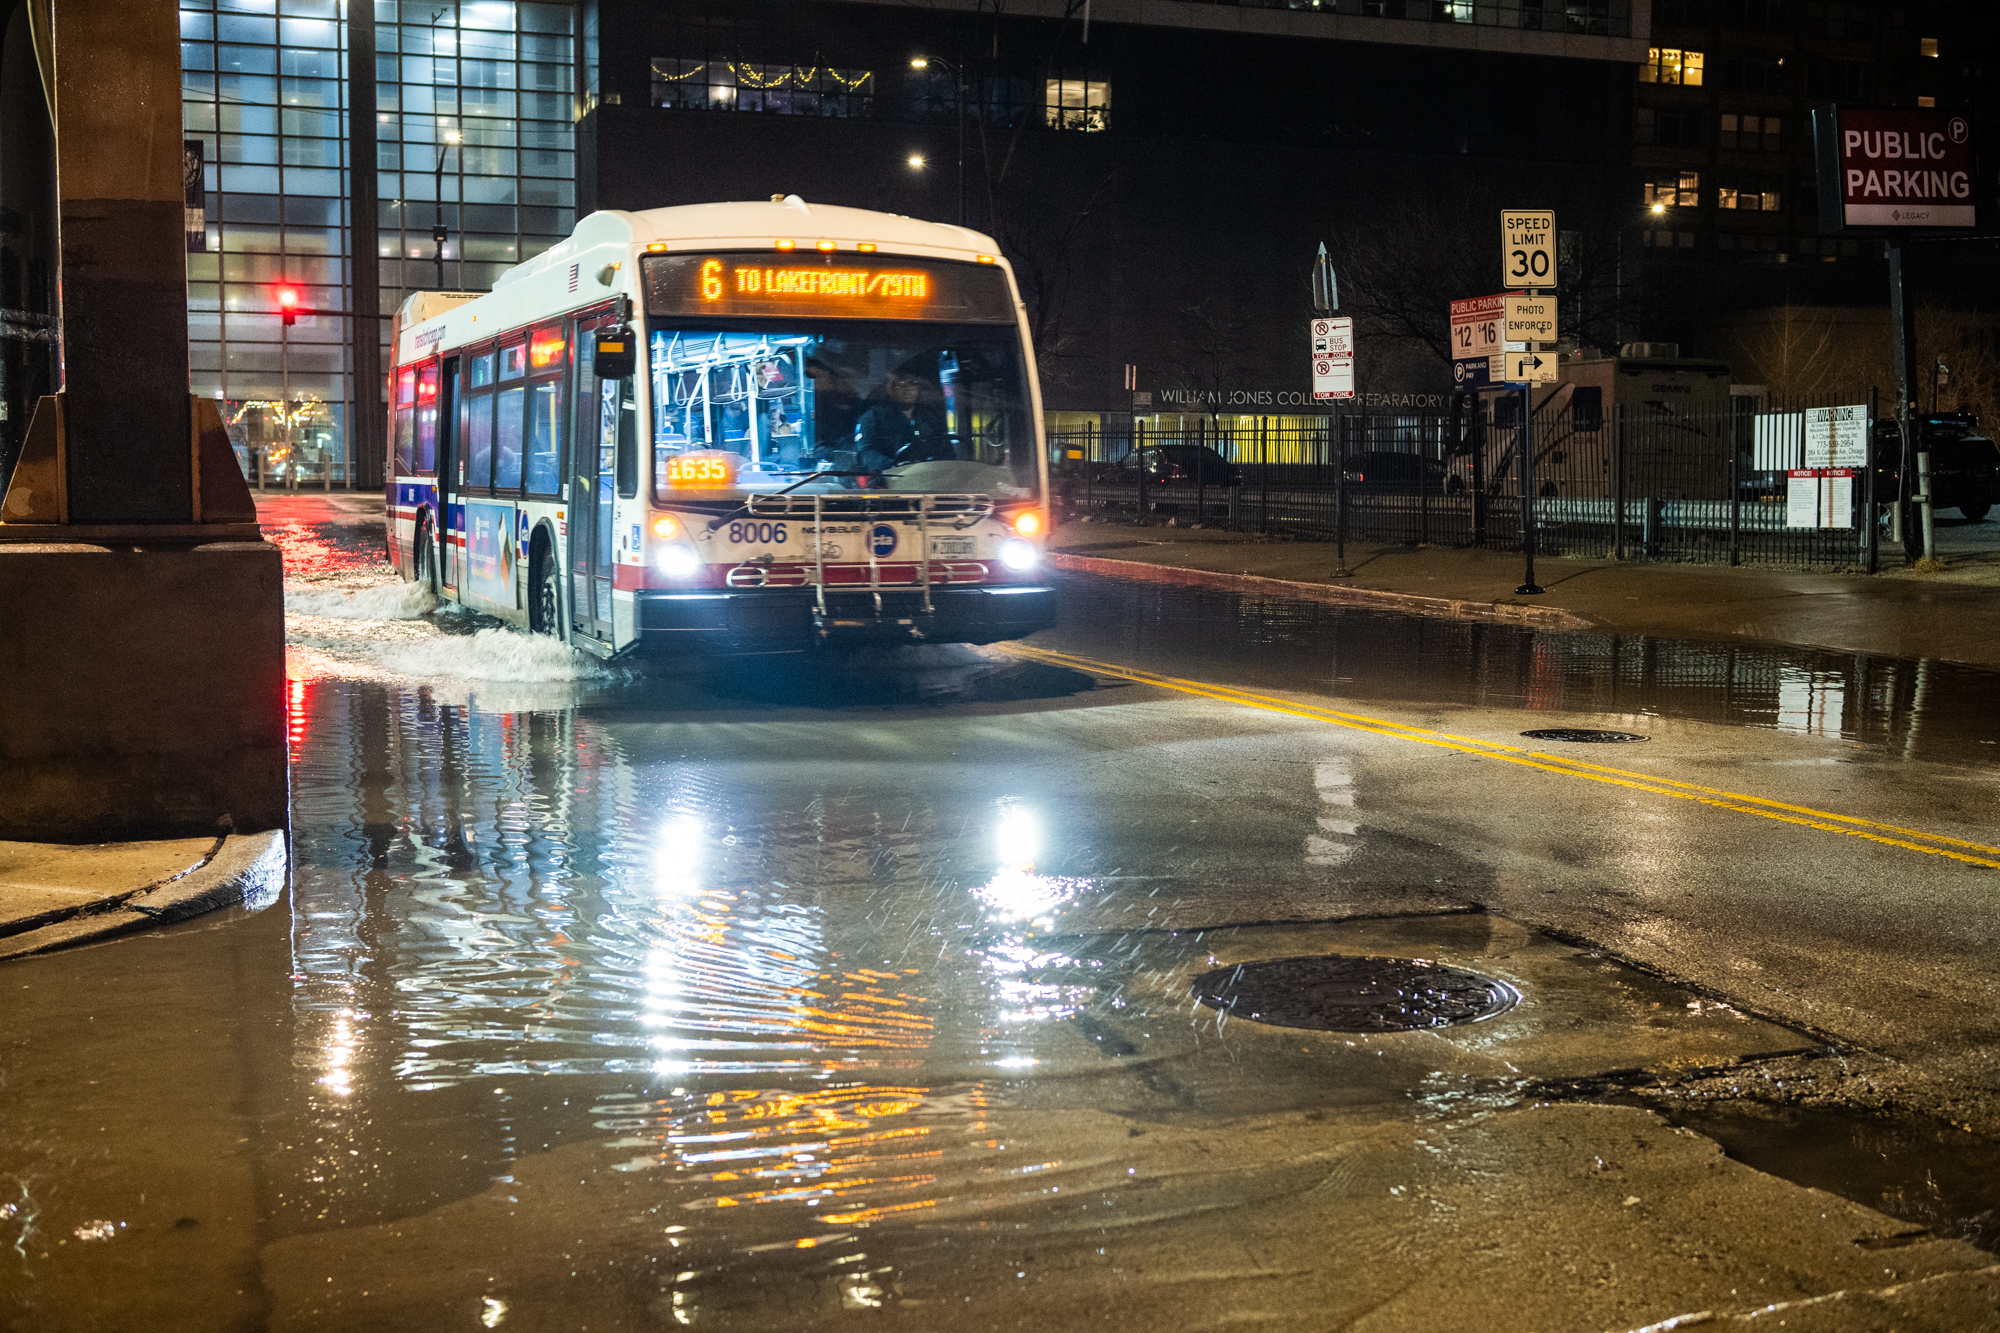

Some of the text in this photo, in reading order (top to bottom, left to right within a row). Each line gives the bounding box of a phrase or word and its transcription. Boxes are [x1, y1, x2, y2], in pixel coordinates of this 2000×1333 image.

[1844, 130, 1946, 160] PUBLIC
[1847, 170, 1970, 198] PARKING
[1507, 218, 1550, 230] SPEED
[1512, 234, 1546, 245] LIMIT
[1512, 250, 1550, 277] 30
[702, 260, 722, 300] 6
[735, 269, 926, 297] TO LAKEFRONT/79TH
[1452, 296, 1504, 314] PUBLIC PARKIN
[1517, 306, 1544, 314] PHOTO
[1478, 322, 1496, 344] $16
[1509, 321, 1552, 330] ENFORCED
[1454, 326, 1472, 347] $12
[1161, 390, 1221, 404] WILLIAM
[1227, 390, 1272, 405] JONES
[1652, 384, 1691, 393] GEMINI
[1819, 408, 1853, 421] WARNING
[729, 522, 787, 543] 8006
